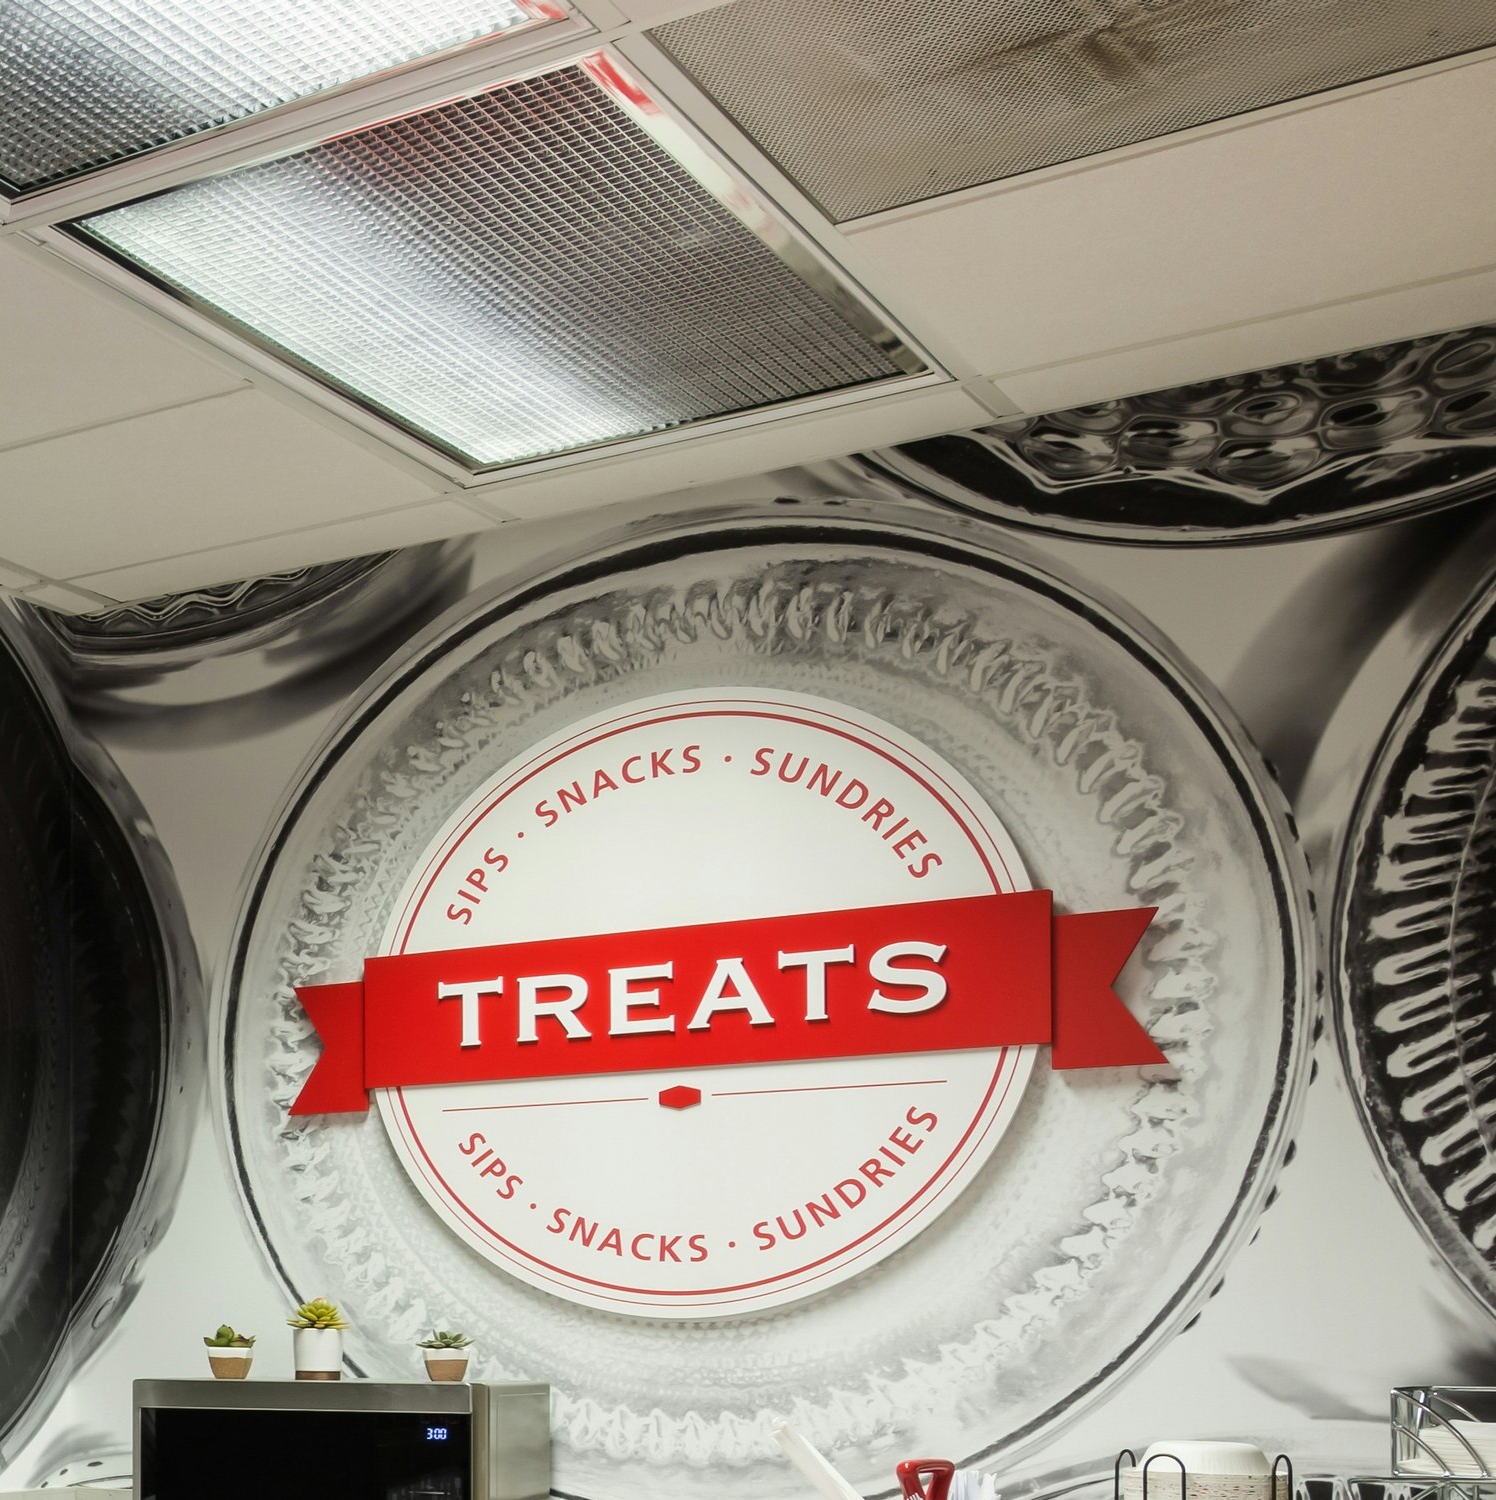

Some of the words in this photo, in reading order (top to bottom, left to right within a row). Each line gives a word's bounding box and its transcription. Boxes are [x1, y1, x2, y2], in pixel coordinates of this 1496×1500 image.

[447, 847, 509, 925] SIPS
[534, 745, 702, 828] SNACKS
[750, 747, 943, 880] SUNDRIES
[437, 940, 951, 1049] TREATS
[457, 1132, 523, 1200] SIPS
[547, 1207, 708, 1263] SNACKS
[753, 1107, 938, 1250] SUNDRIES
